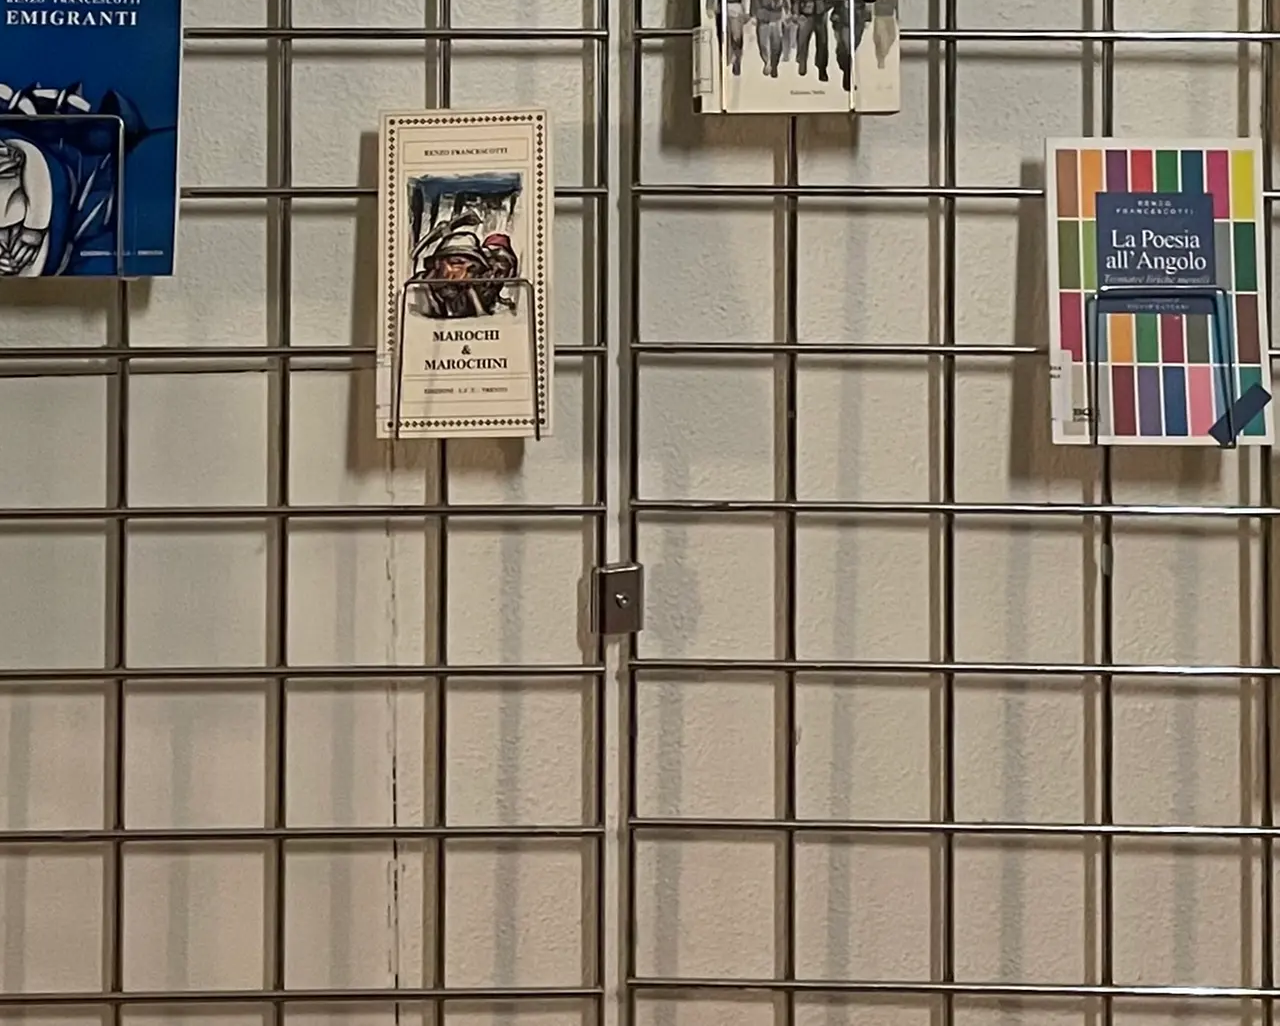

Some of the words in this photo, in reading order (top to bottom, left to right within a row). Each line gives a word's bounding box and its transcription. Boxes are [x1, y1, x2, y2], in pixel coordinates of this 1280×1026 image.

[6, 10, 137, 26] EMIGRANTI
[1112, 229, 1136, 248] La
[1141, 228, 1200, 249] Poesia
[432, 330, 500, 342] MAROCHI
[461, 344, 471, 355] &
[424, 358, 508, 371] MAROCHINI
